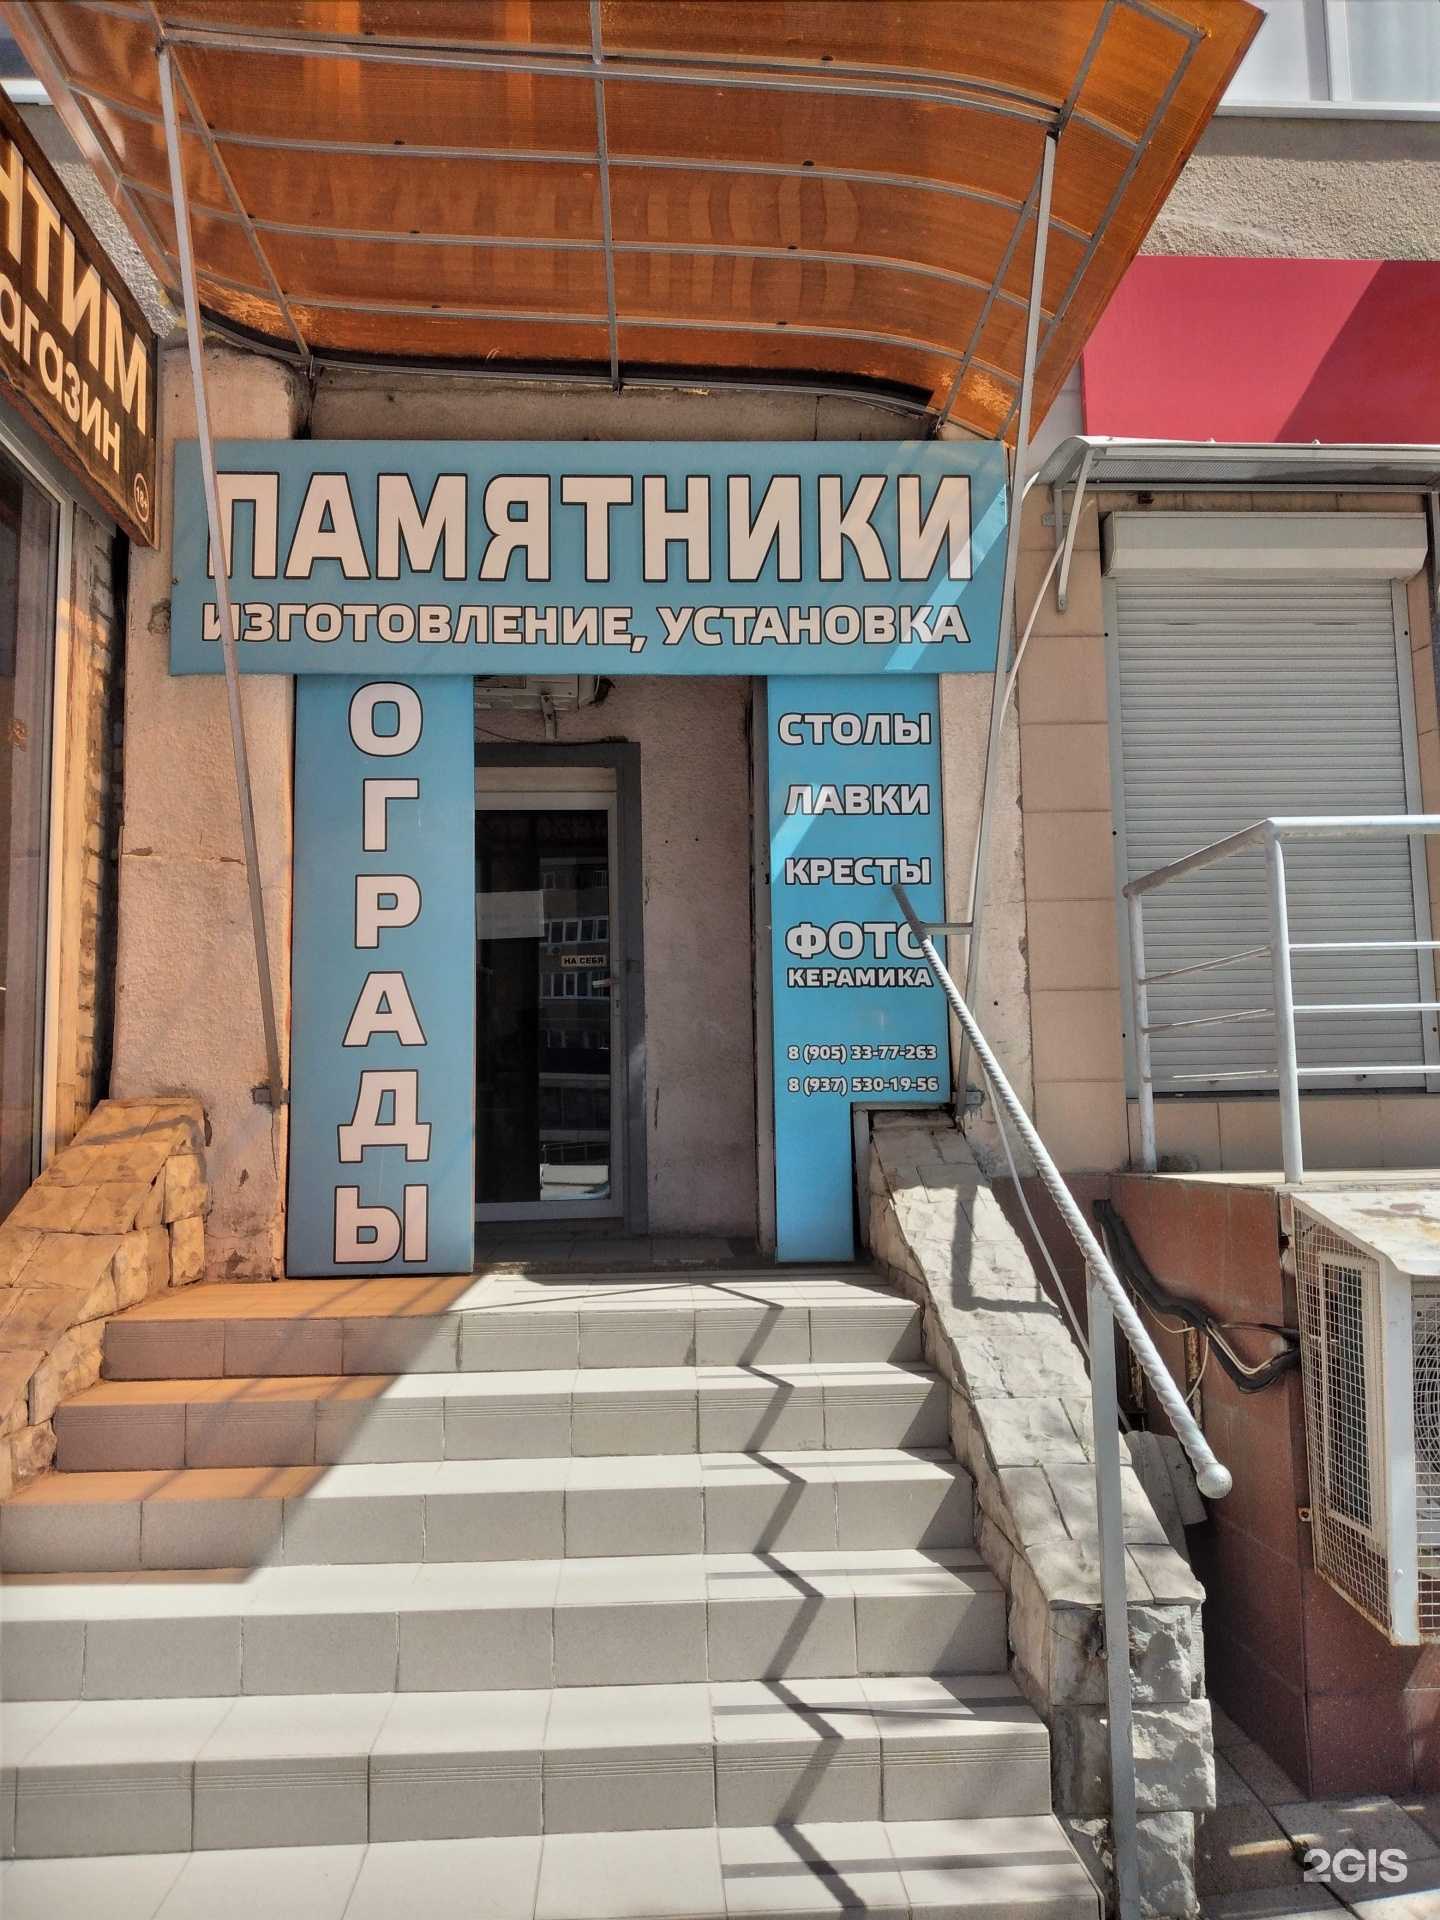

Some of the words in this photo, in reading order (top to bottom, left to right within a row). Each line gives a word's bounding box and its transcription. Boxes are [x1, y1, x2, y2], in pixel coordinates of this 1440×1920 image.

[207, 471, 973, 581] ПАМЯТНИКИ
[203, 602, 647, 653] ИЗГОТОВЛЕНИЕ,
[657, 605, 971, 645] УСТАНОВКА
[778, 712, 931, 745] СТОЛЫ
[785, 784, 930, 816] ЛАВКИ
[785, 858, 931, 886] КРЕСТЫ
[785, 921, 934, 960] ФОТО
[334, 681, 432, 1265] ОГРАДЫ
[564, 957, 577, 965] НА
[580, 956, 604, 965] СЕБЯ
[786, 967, 934, 988] КЕРАМИКА
[788, 1045, 800, 1060] 8
[803, 1043, 847, 1064] (905)
[850, 1045, 937, 1060] 33-77-263
[788, 1077, 800, 1092] 8
[803, 1075, 847, 1096] (937)
[851, 1076, 939, 1092] 530-19-56
